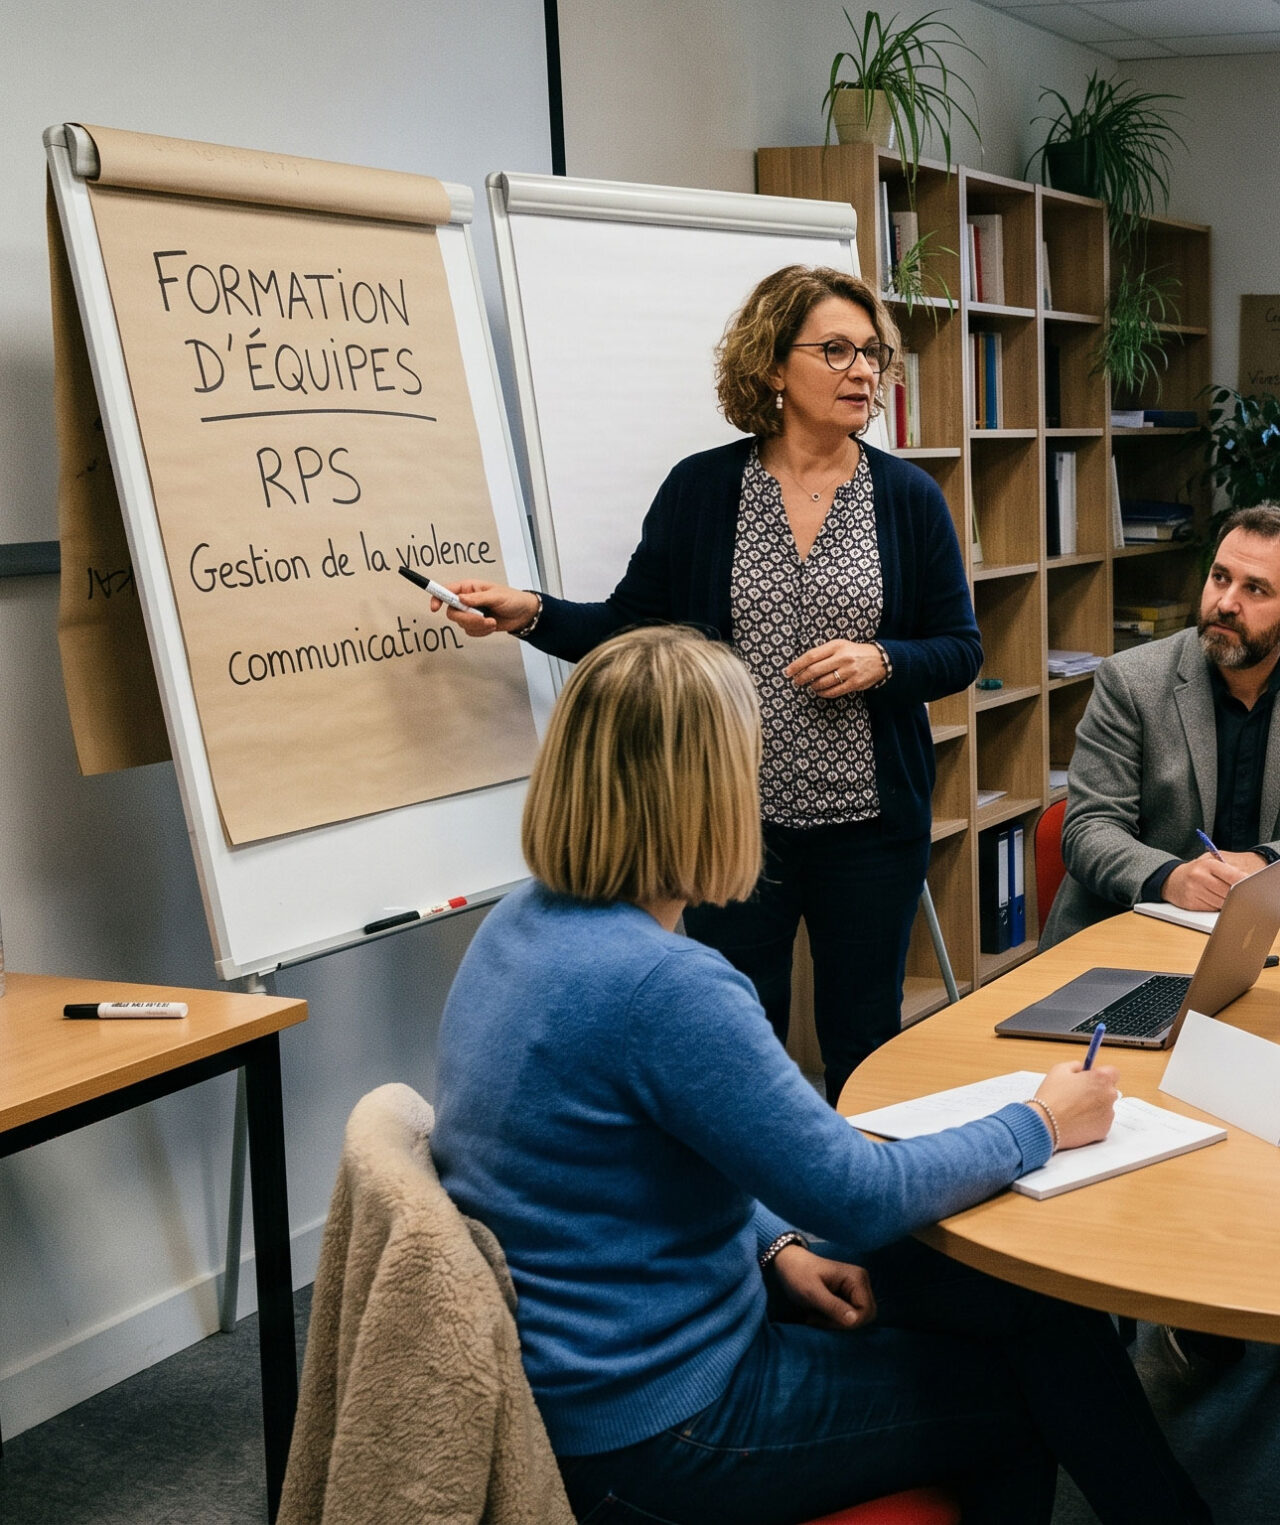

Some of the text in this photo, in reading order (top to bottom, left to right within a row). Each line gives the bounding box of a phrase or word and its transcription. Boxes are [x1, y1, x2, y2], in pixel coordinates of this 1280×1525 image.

[257, 447, 361, 508] RPS
[190, 523, 496, 592] Gestion de la violence
